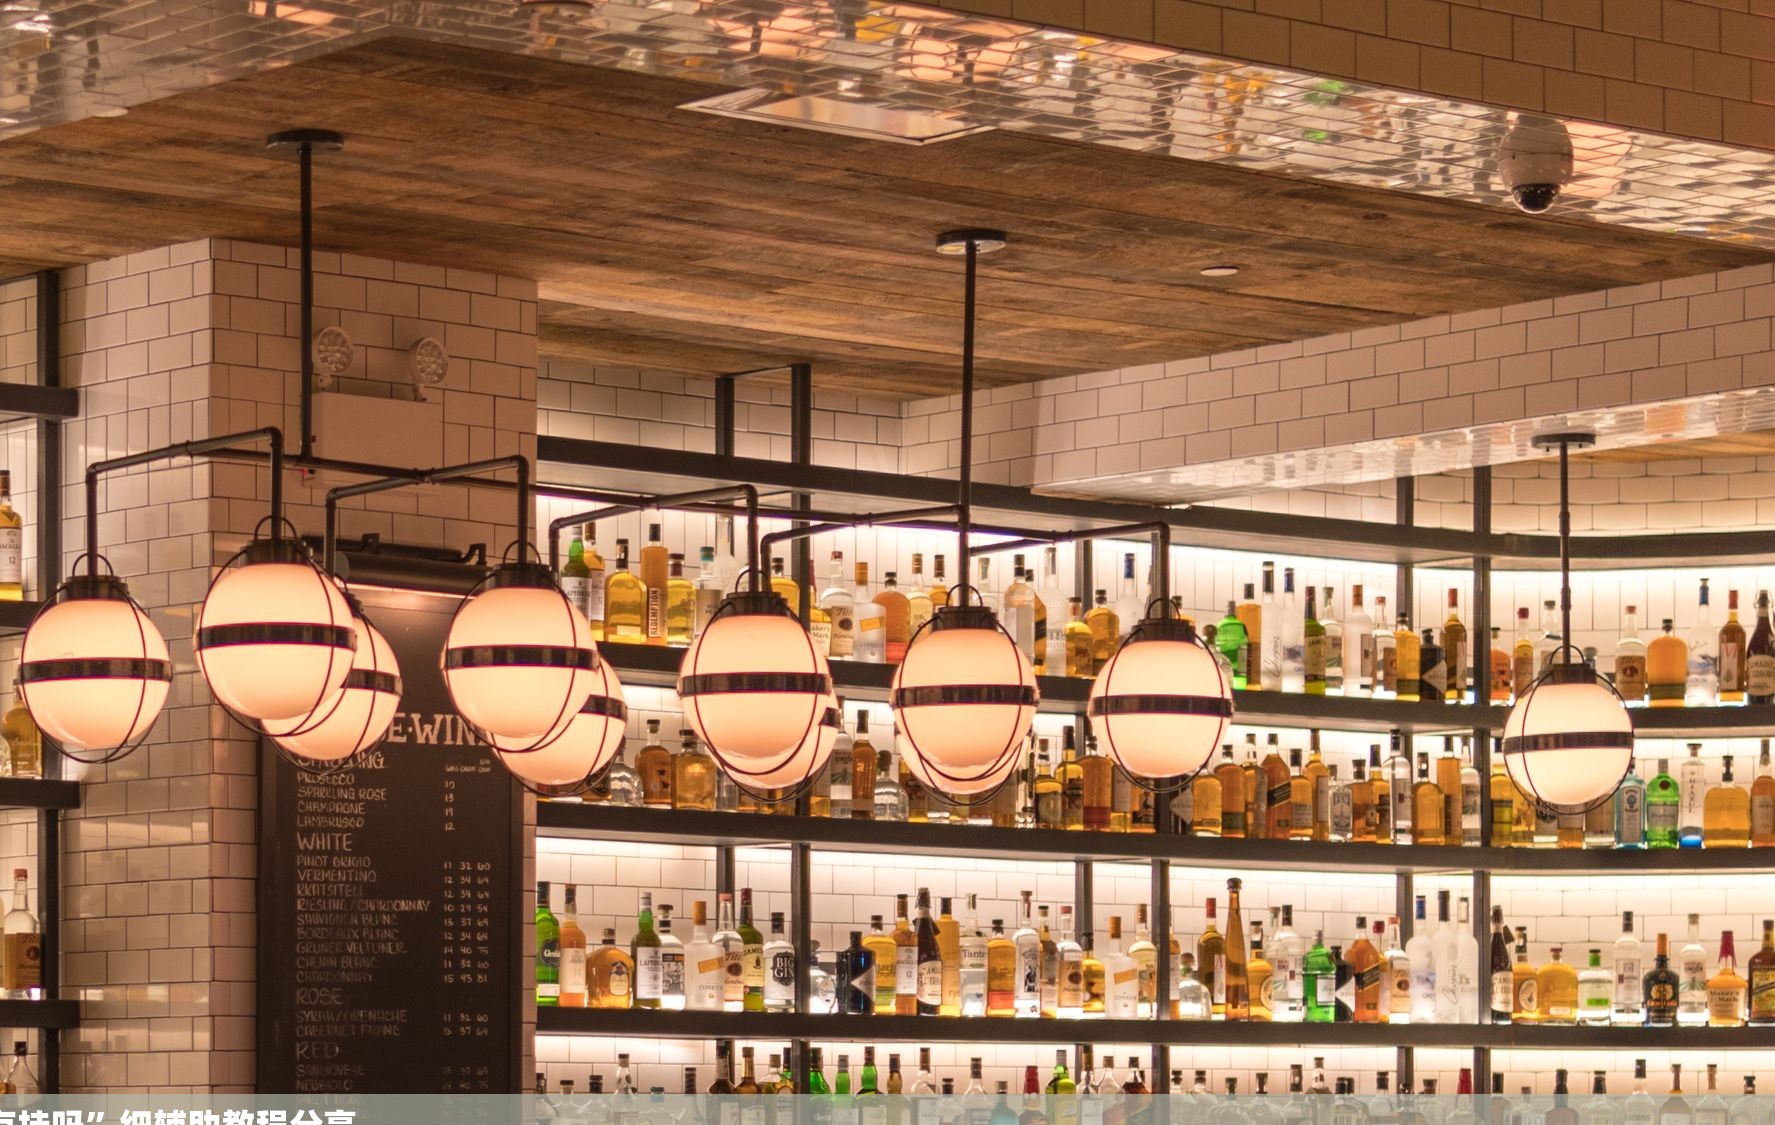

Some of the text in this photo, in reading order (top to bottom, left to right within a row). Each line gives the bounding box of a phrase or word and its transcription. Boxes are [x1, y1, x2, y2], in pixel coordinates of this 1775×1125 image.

[9, 556, 17, 566] 12
[650, 589, 660, 636] REDEMPTION
[444, 780, 455, 790] 10
[297, 787, 455, 803] SPARKLING ROSE 13
[297, 800, 454, 817] CHAMPAGNE 19
[297, 815, 456, 831] LAMBRUSCO 12
[296, 832, 353, 851] WHITE
[297, 855, 491, 871] PINOT GRIGIO 11 32 60
[297, 869, 377, 883] VERMENTINO
[443, 875, 454, 885] 12
[459, 876, 471, 886] 34
[443, 889, 454, 899] 12
[459, 889, 471, 899] 34
[444, 903, 454, 912] 10
[460, 917, 472, 927] 37
[443, 931, 454, 941] 12
[460, 931, 472, 941] 34
[443, 946, 454, 956] 14
[460, 946, 473, 956] 40
[443, 960, 452, 969] 11
[776, 956, 795, 967] BIG
[443, 974, 455, 983] 15
[476, 974, 488, 983] 81
[296, 987, 345, 1005] ROSE
[443, 1014, 452, 1022] 11
[296, 1041, 339, 1060] RED
